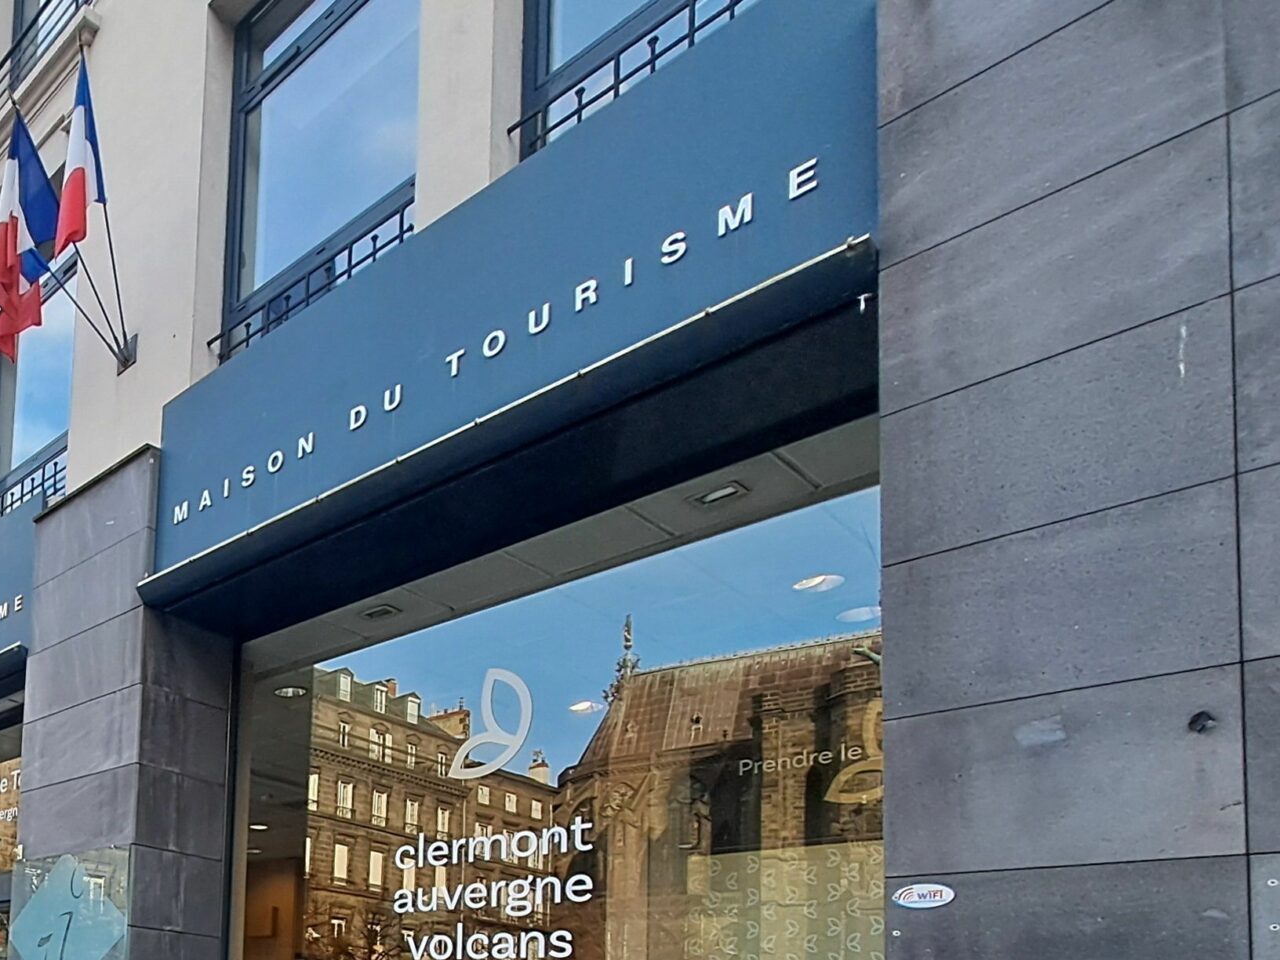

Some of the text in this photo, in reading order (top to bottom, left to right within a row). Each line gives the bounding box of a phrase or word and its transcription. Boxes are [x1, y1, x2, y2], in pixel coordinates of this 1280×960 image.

[173, 157, 819, 526] MAISON DU TOURISME
[738, 742, 863, 776] Prendre le
[394, 815, 594, 871] clermont
[392, 872, 594, 918] auvergne
[405, 922, 574, 960] volcans
